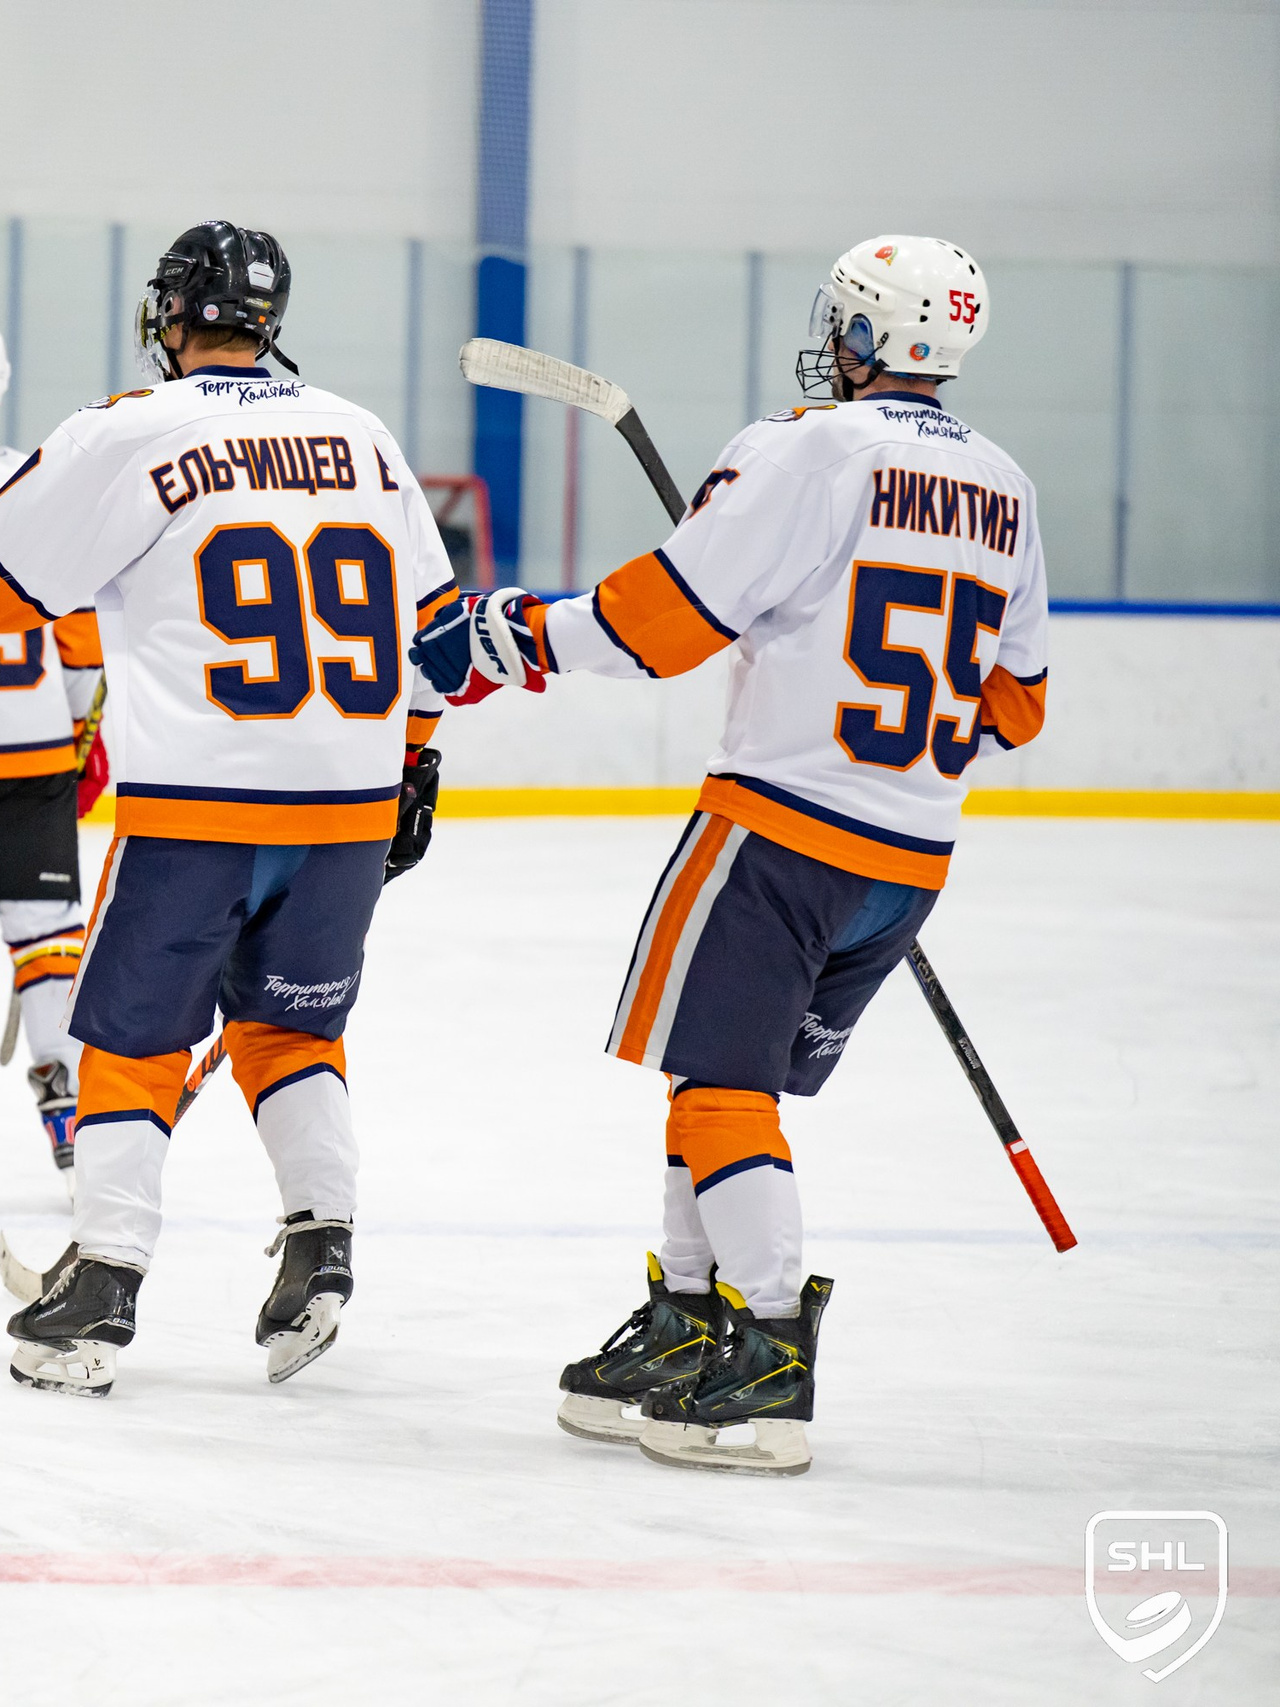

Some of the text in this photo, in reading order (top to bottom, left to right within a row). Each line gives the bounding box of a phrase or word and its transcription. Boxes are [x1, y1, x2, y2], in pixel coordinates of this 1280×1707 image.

[165, 266, 184, 276] CCM
[949, 289, 976, 325] 55
[149, 435, 357, 515] ЕЛЬЧИЩЕВ
[870, 467, 1019, 557] НИКИТИН
[194, 522, 402, 720] 99
[833, 560, 1008, 780] 55
